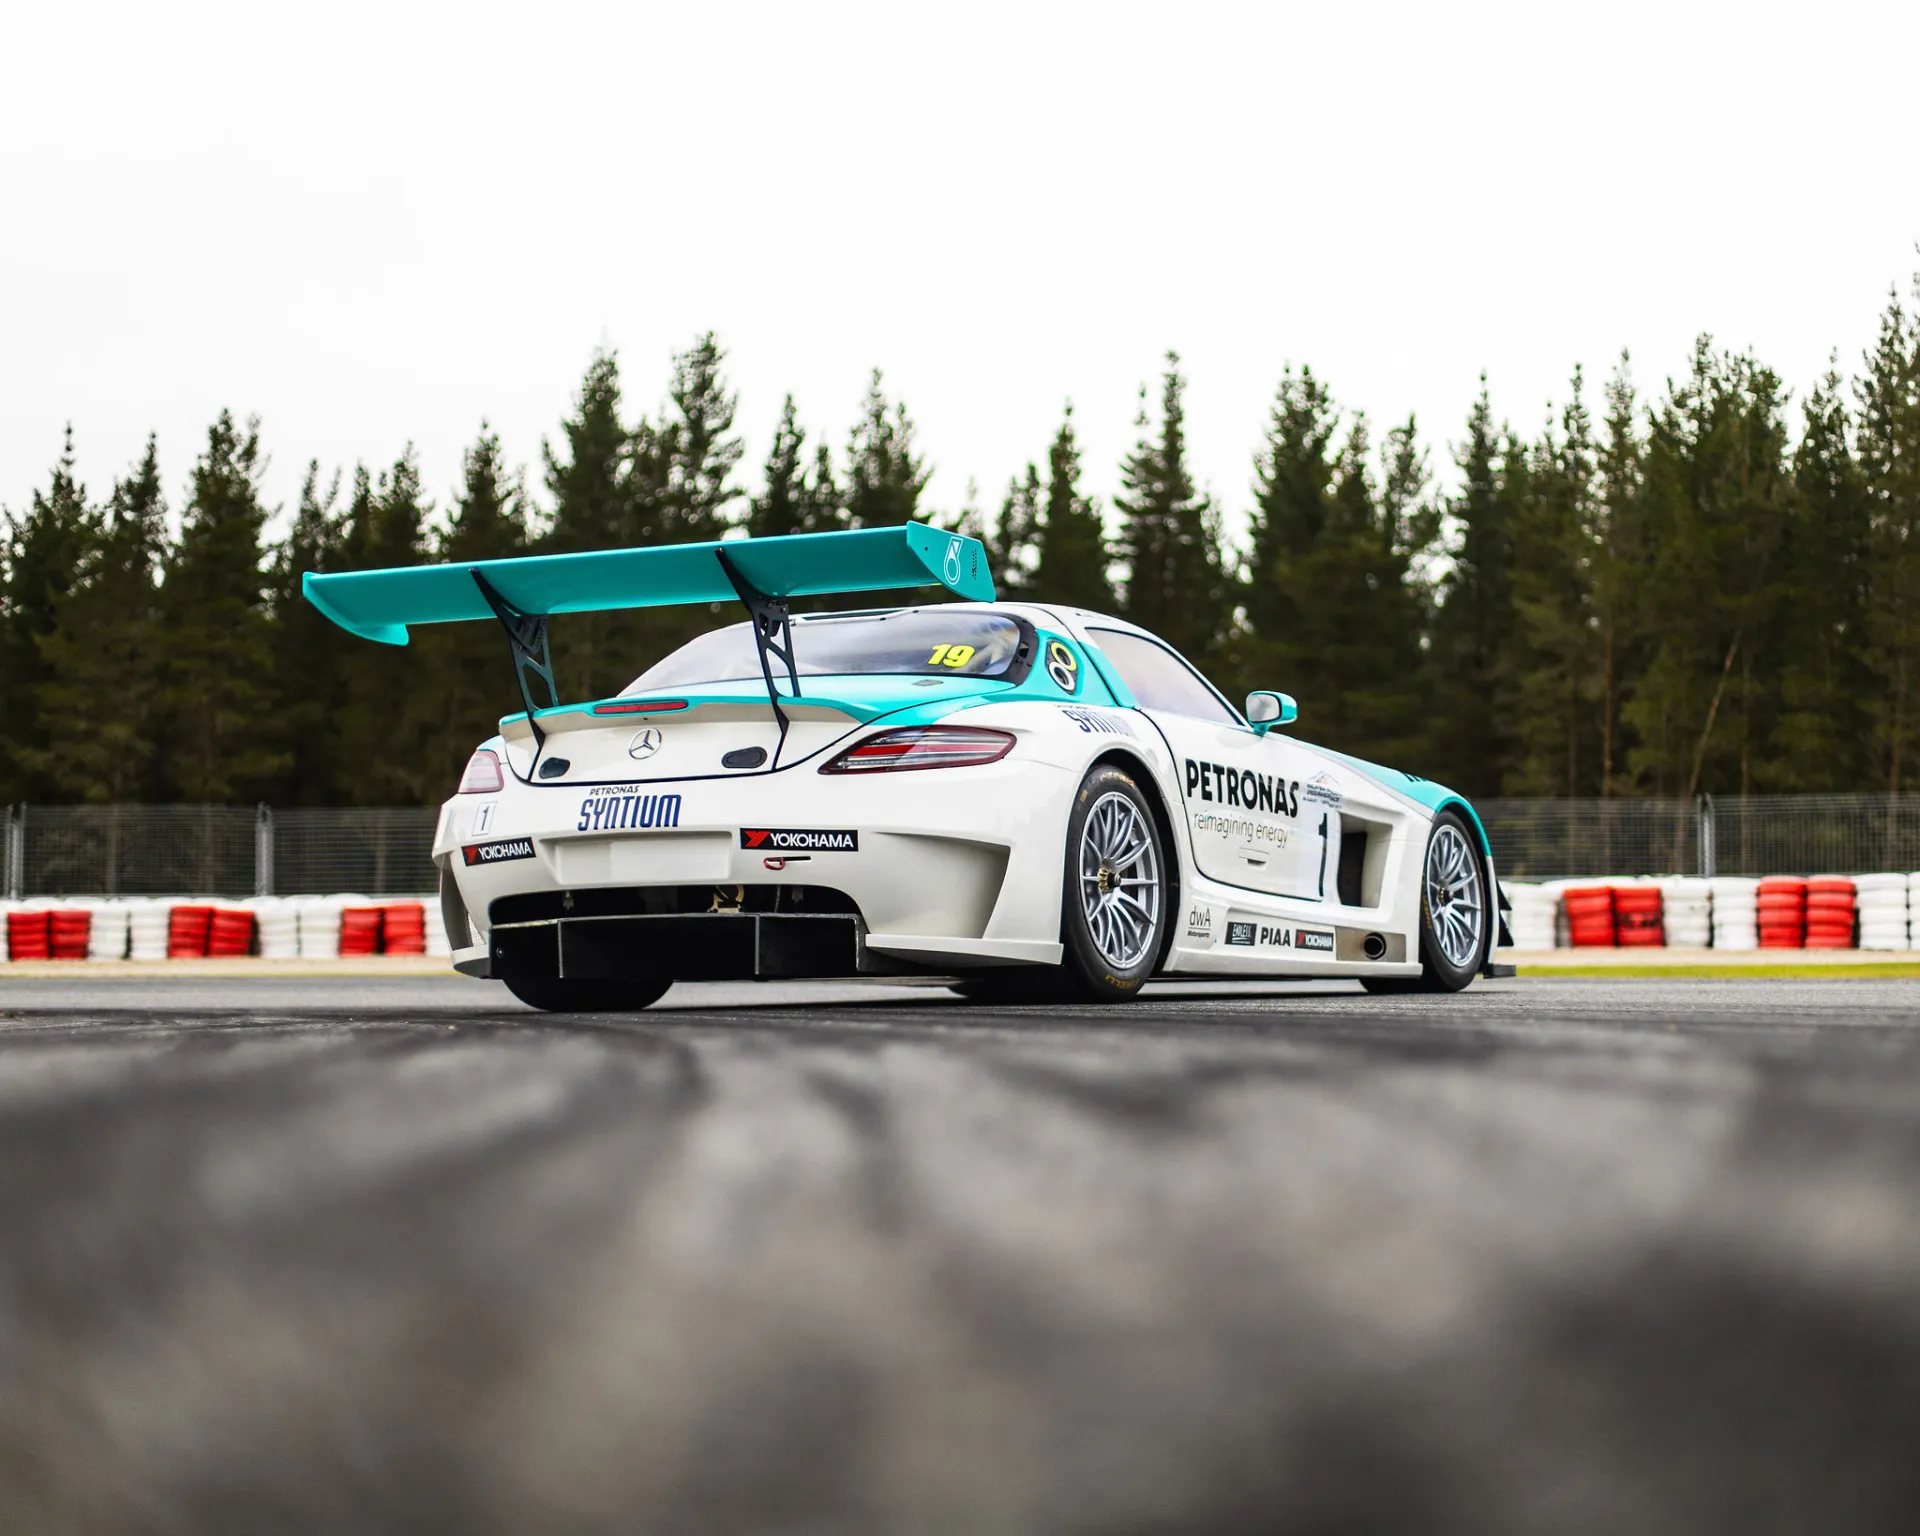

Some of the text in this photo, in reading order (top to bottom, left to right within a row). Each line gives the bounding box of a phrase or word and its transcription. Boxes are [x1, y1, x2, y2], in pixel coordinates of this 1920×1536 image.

[928, 643, 976, 668] 19
[589, 785, 640, 796] PETRONAS
[1185, 758, 1299, 818] PETRONAS
[480, 804, 491, 831] 1
[577, 794, 682, 832] SYNTIUM
[770, 833, 855, 848] YOKOHAMA
[1193, 809, 1289, 849] reimagining energy
[478, 841, 533, 860] YOKOHAMA
[1318, 812, 1328, 897] 1
[1189, 905, 1211, 927] dwA
[1260, 926, 1291, 947] PIAA
[1304, 933, 1333, 948] YOKOHAMA
